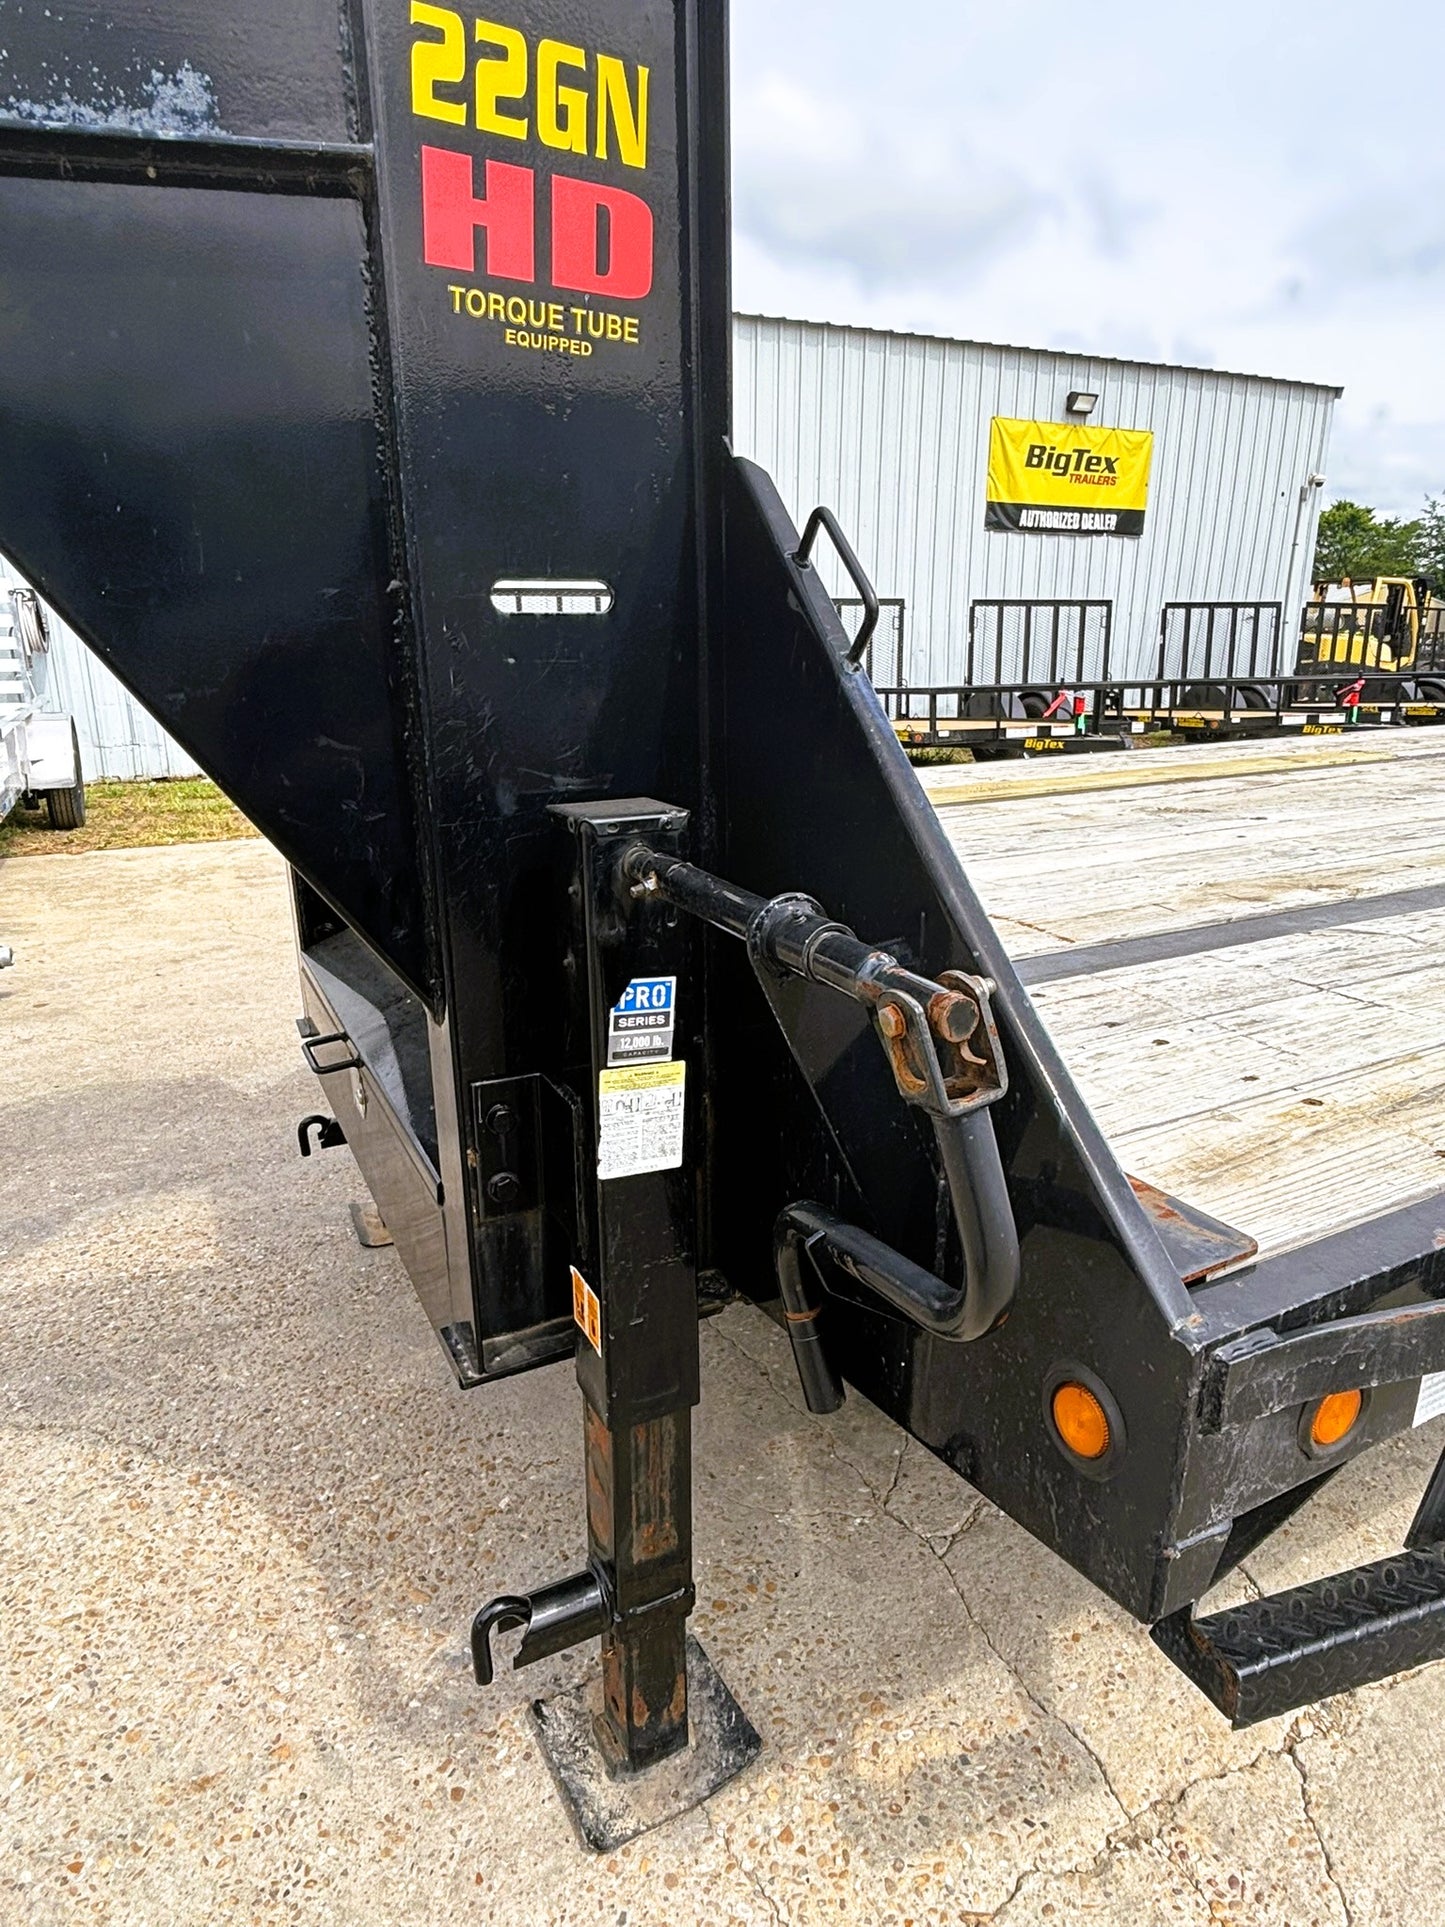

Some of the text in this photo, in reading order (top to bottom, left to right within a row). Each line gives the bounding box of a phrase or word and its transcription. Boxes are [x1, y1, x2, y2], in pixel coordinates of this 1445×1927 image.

[410, 0, 649, 169] 22GN
[421, 145, 653, 300] HD
[448, 285, 640, 344] TORQUE TUBE
[504, 328, 593, 357] EQUIPPED
[1025, 444, 1120, 476] BigTex
[1069, 473, 1118, 486] TRAILERS
[1019, 509, 1118, 531] AUTHORIZED DEALER
[1302, 724, 1344, 736] BigTex
[1023, 737, 1065, 751] BigTex
[618, 1015, 665, 1028] SERIES
[620, 1035, 651, 1050] 12,000
